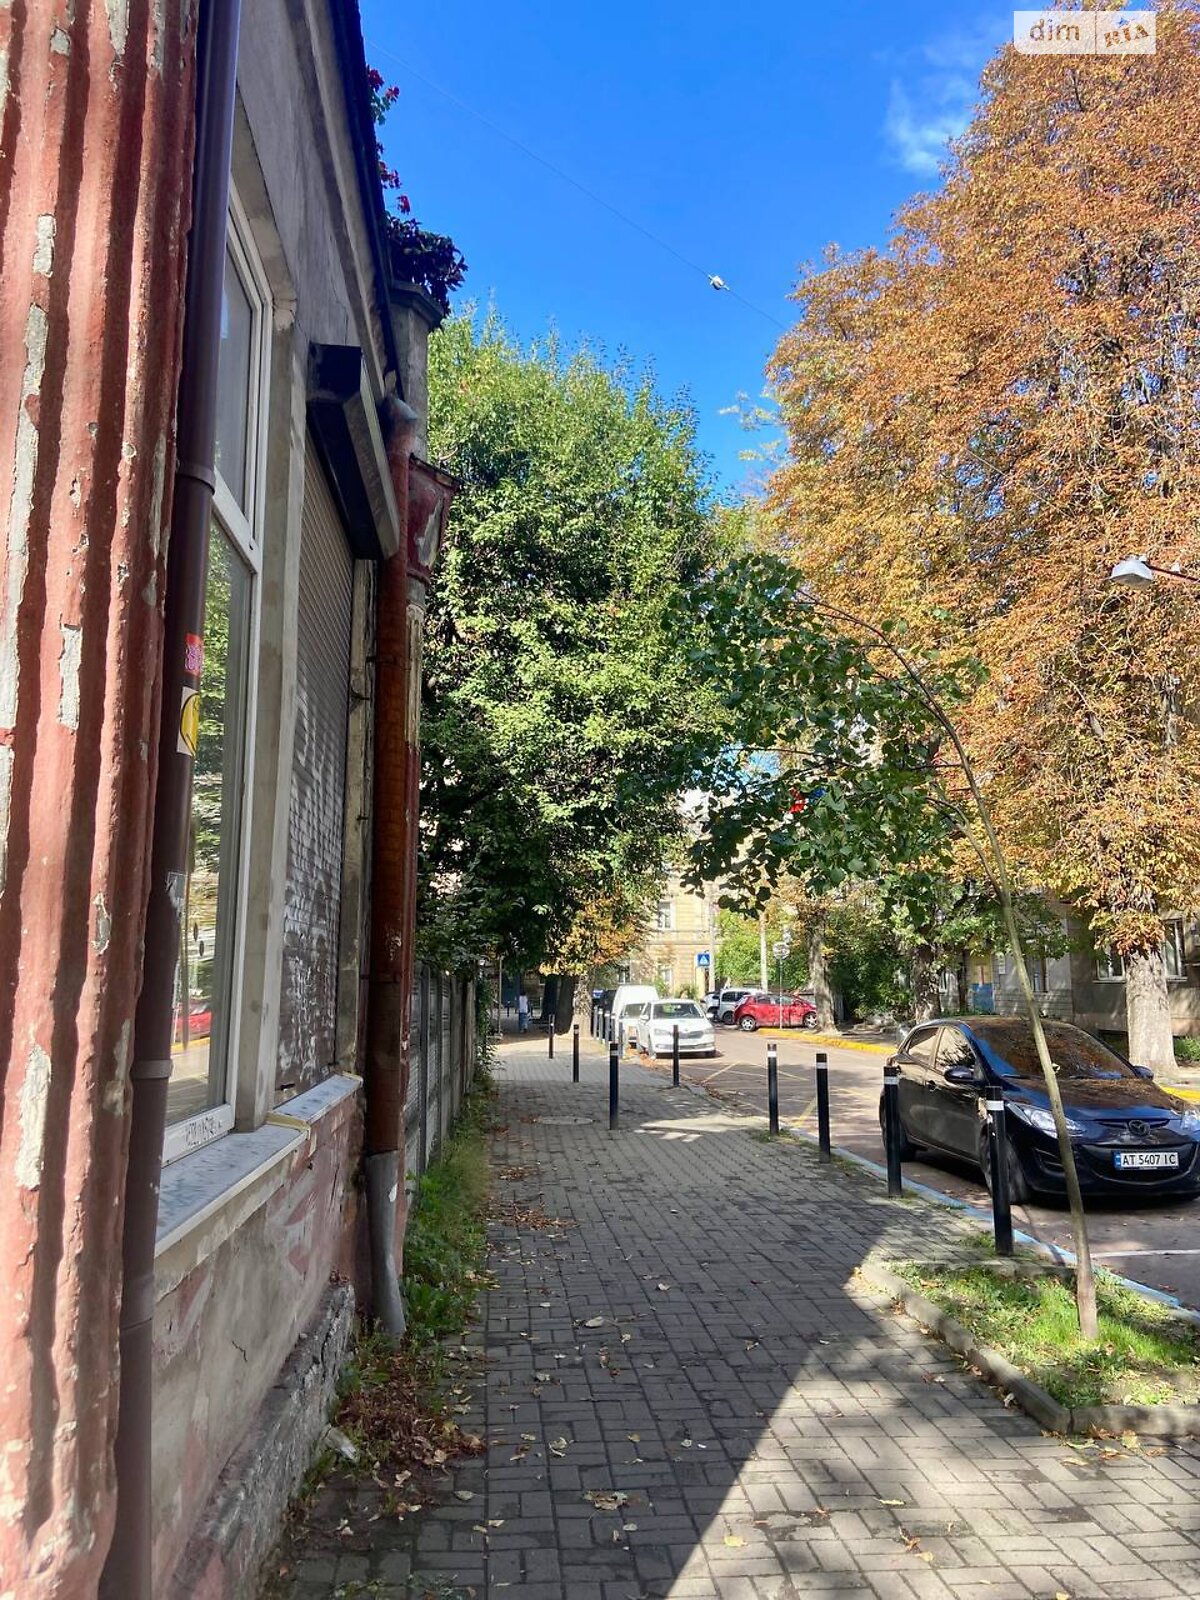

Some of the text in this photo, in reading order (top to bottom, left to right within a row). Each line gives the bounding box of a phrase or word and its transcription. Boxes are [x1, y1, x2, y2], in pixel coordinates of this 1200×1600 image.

[1122, 1153, 1176, 1165] AT 5407 IC
